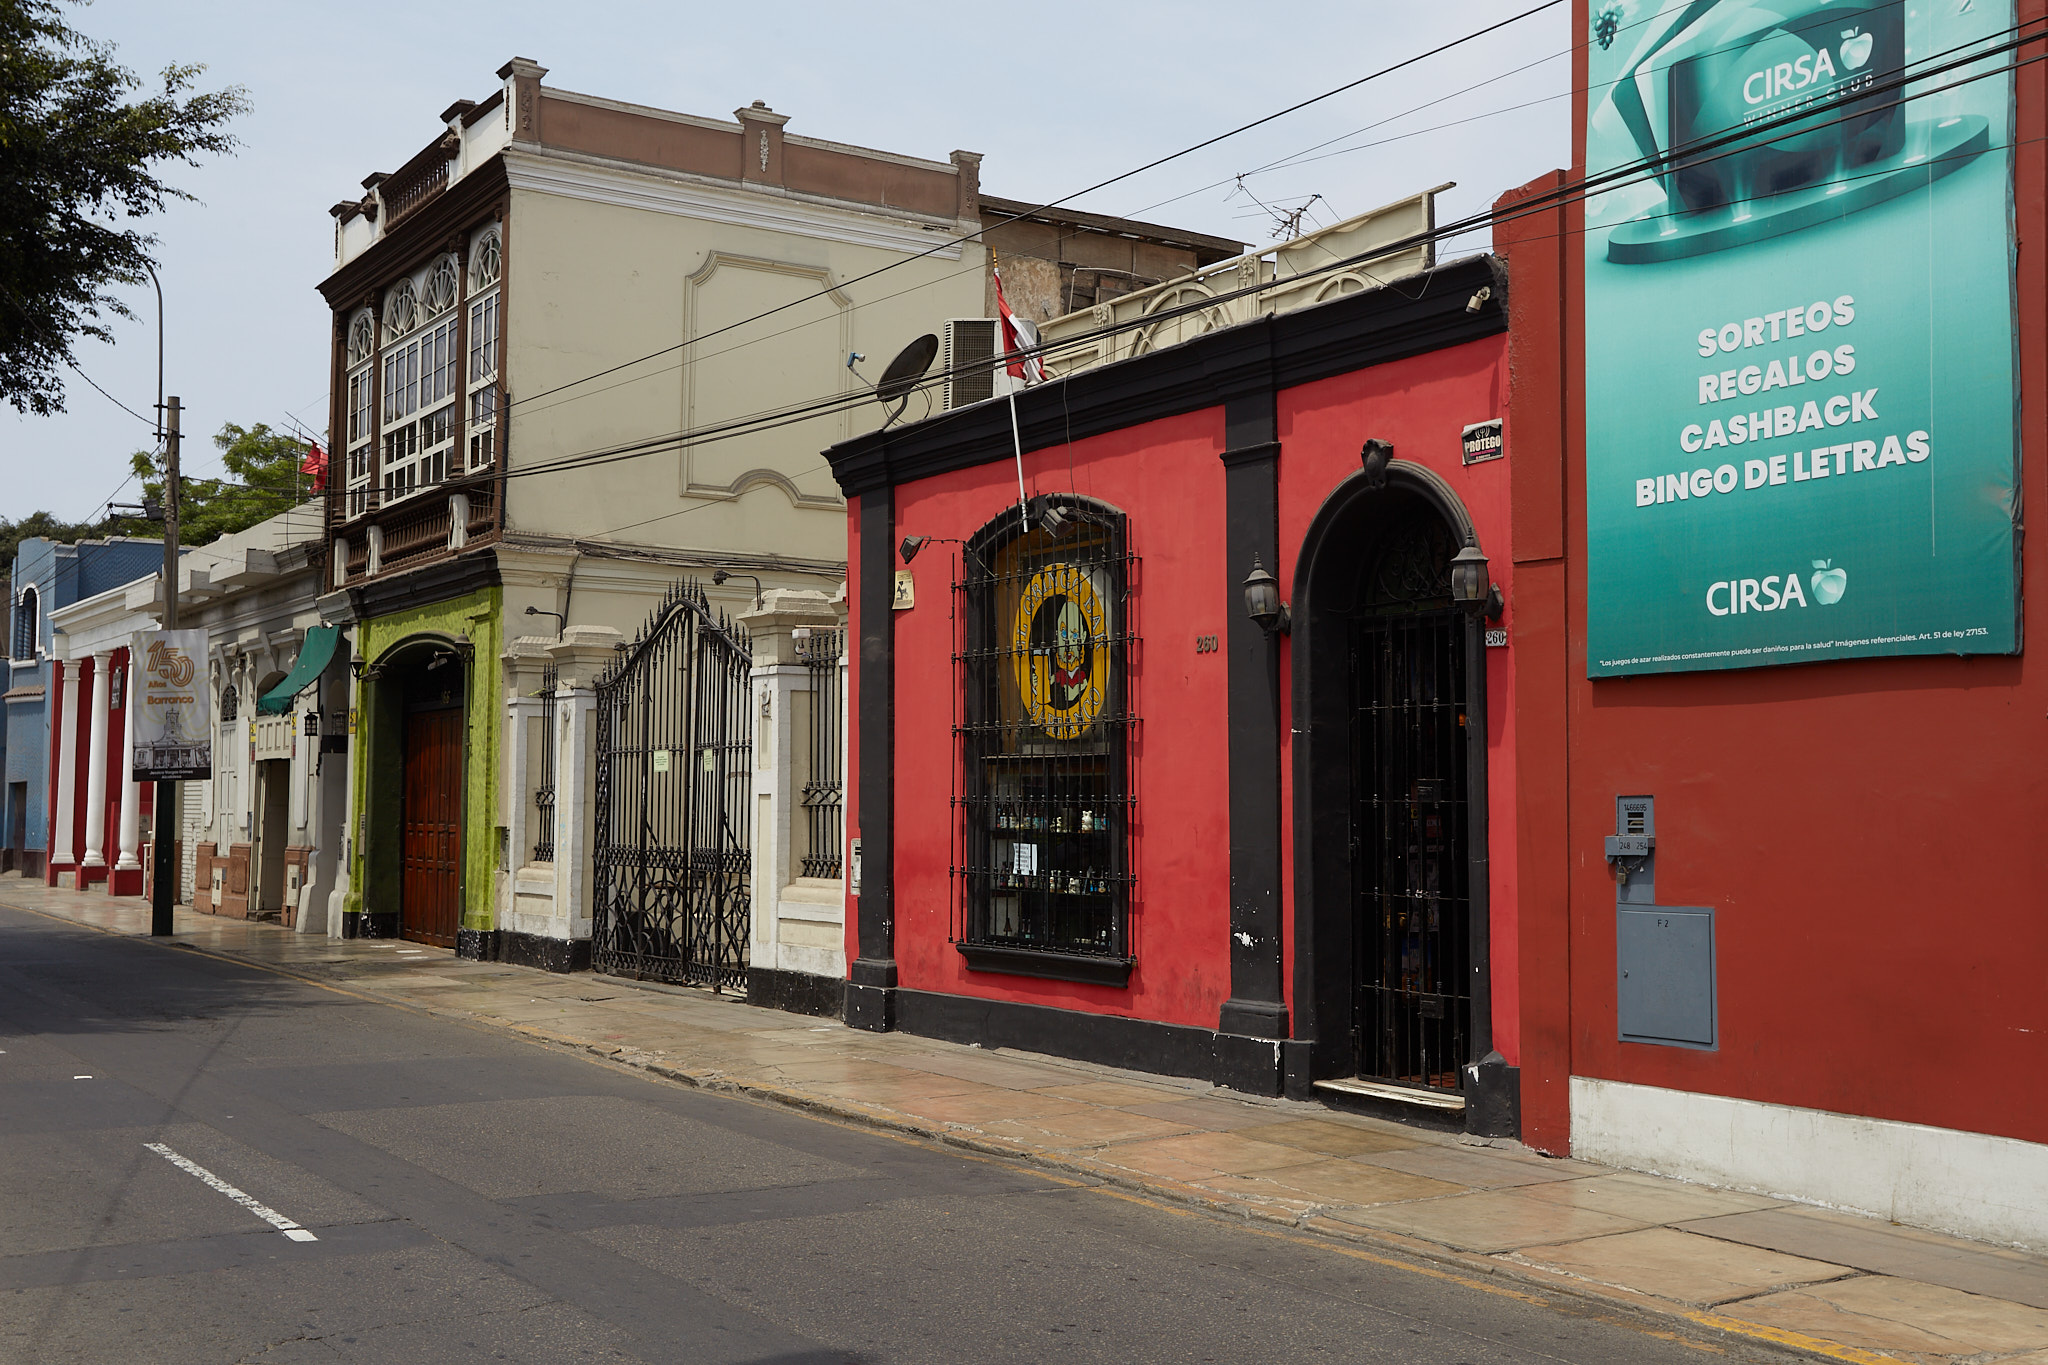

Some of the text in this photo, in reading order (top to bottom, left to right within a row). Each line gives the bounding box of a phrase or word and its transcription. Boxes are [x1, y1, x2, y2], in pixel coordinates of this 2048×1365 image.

[1743, 48, 1837, 105] CIRSA
[1743, 74, 1874, 128] WINNER CLUB
[1697, 294, 1856, 358] SORTEOS
[1698, 344, 1857, 405] REGALOS
[1680, 387, 1880, 454] CASHBACK
[1464, 435, 1501, 453] PROTEGO
[1636, 430, 1931, 507] BINGO DE LETRAS
[1023, 571, 1083, 616] GRINGO
[1084, 597, 1105, 652] BAR
[1706, 573, 1807, 616] CIRSA
[1196, 634, 1218, 653] 260
[1486, 631, 1504, 644] 260
[1612, 658, 1631, 667] juegos
[1631, 656, 1639, 664] de
[1652, 653, 1681, 662] realizados
[1681, 648, 1731, 660] constantemente
[1731, 647, 1752, 656] puede
[1752, 646, 1762, 654] ser
[1763, 644, 1789, 653] daniños
[1790, 643, 1805, 652] para
[1805, 641, 1812, 650] la
[1834, 639, 1870, 648] Imágenes
[1870, 633, 1918, 645] referenciales.
[1933, 631, 1941, 639] 51
[1953, 629, 1965, 639] ley
[1965, 627, 1989, 637] 27153.
[147, 640, 194, 688] 150
[148, 680, 167, 689] Años
[147, 695, 195, 705] Barranco
[1619, 841, 1631, 850] 248
